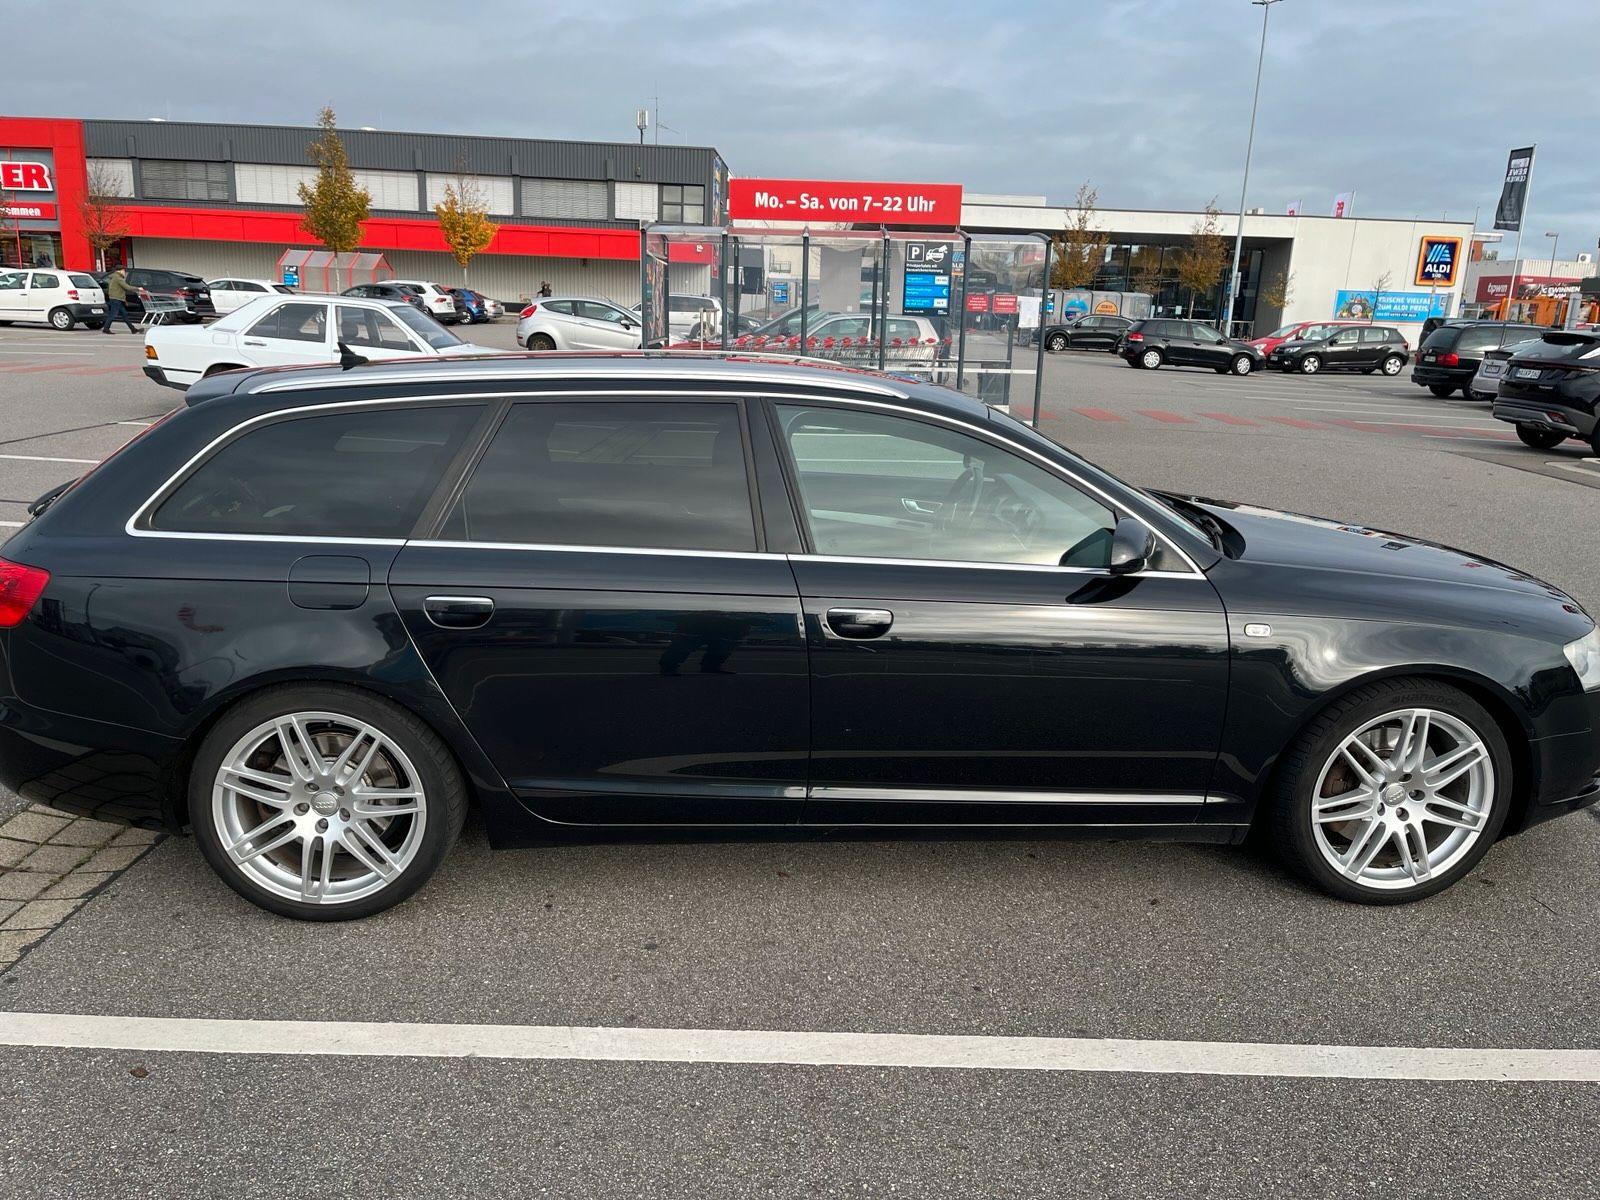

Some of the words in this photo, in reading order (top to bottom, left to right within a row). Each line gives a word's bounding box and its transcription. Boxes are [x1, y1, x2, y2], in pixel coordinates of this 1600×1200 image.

[755, 192, 784, 209] Mo.
[800, 193, 824, 210] Sa.
[829, 198, 858, 211] von
[908, 196, 936, 212] Uhr
[911, 246, 920, 259] P
[1424, 264, 1451, 273] ALDI
[1377, 303, 1392, 311] ZUM
